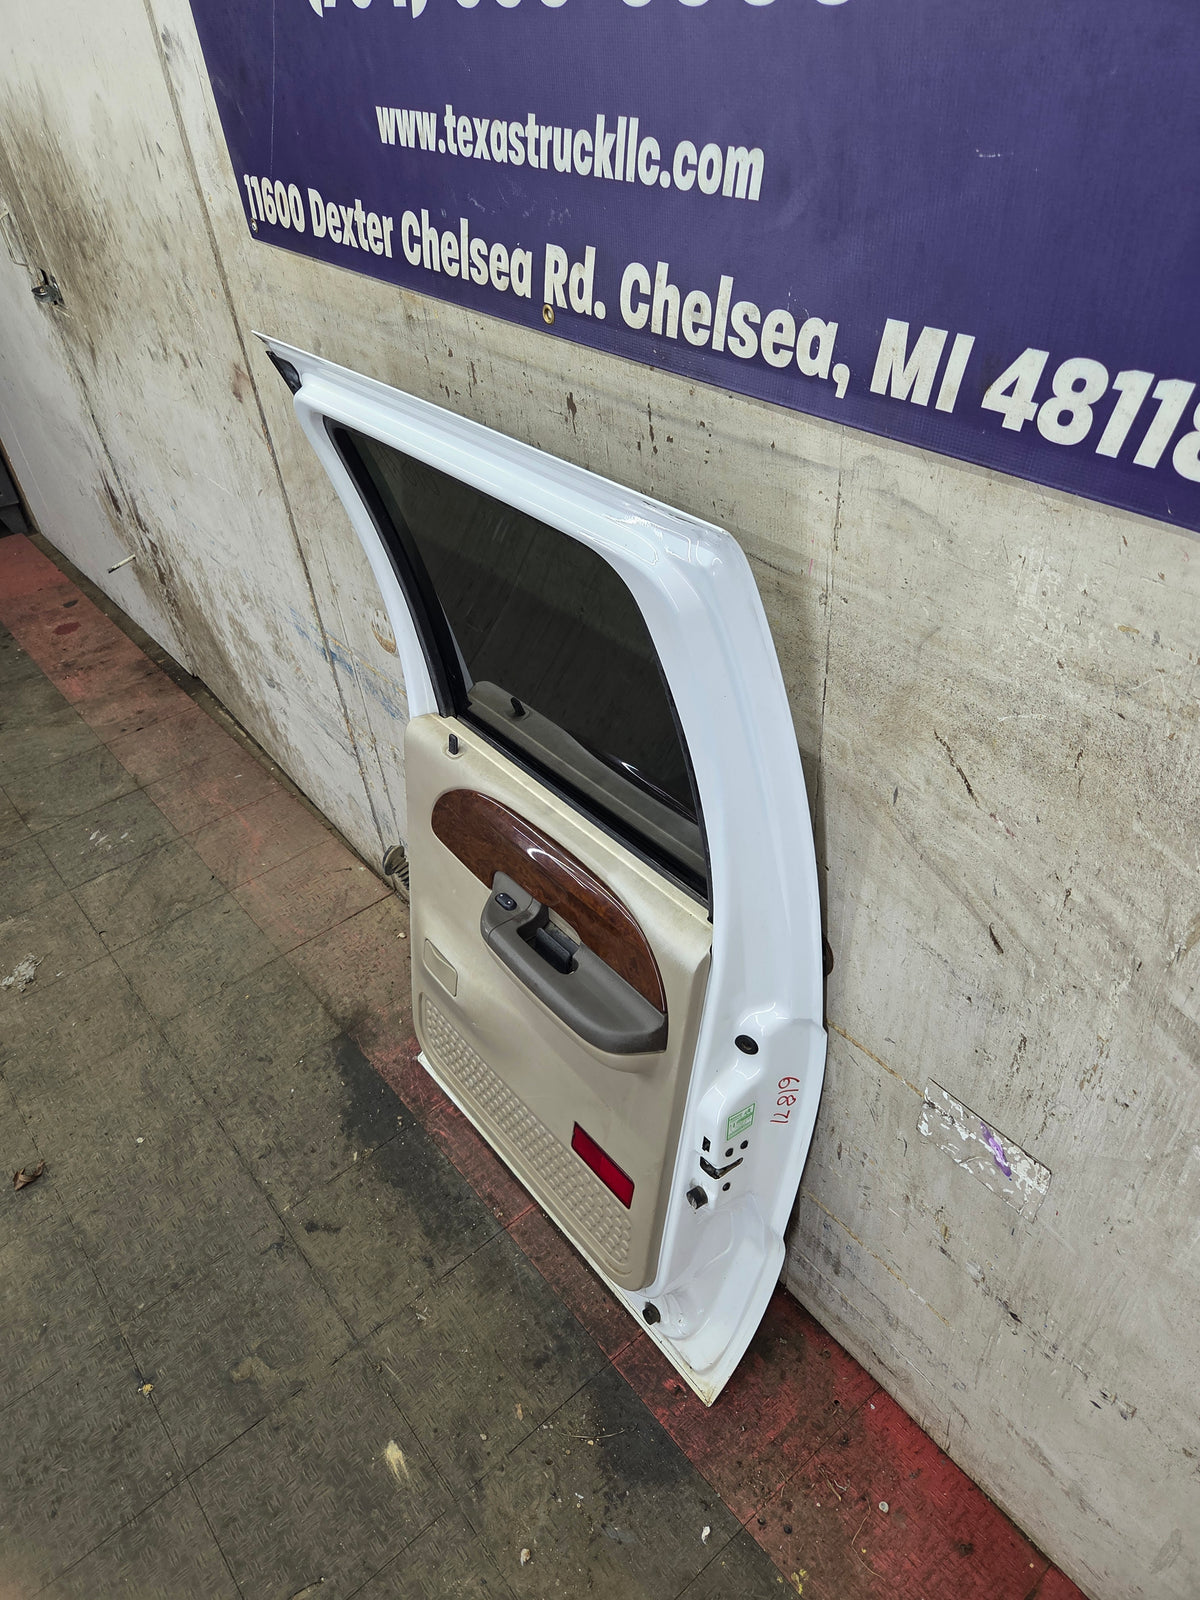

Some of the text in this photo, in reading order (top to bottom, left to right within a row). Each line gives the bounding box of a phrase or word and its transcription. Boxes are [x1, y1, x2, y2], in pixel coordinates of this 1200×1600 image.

[375, 103, 765, 202] www.texastruckllc.com
[243, 173, 306, 233] 11600
[307, 187, 394, 259] Dexter
[401, 208, 533, 299] Chelsea
[543, 242, 606, 320] Rd.
[619, 260, 851, 399] Chelsea,
[869, 317, 976, 414] MI
[770, 1076, 800, 1124] 61871
